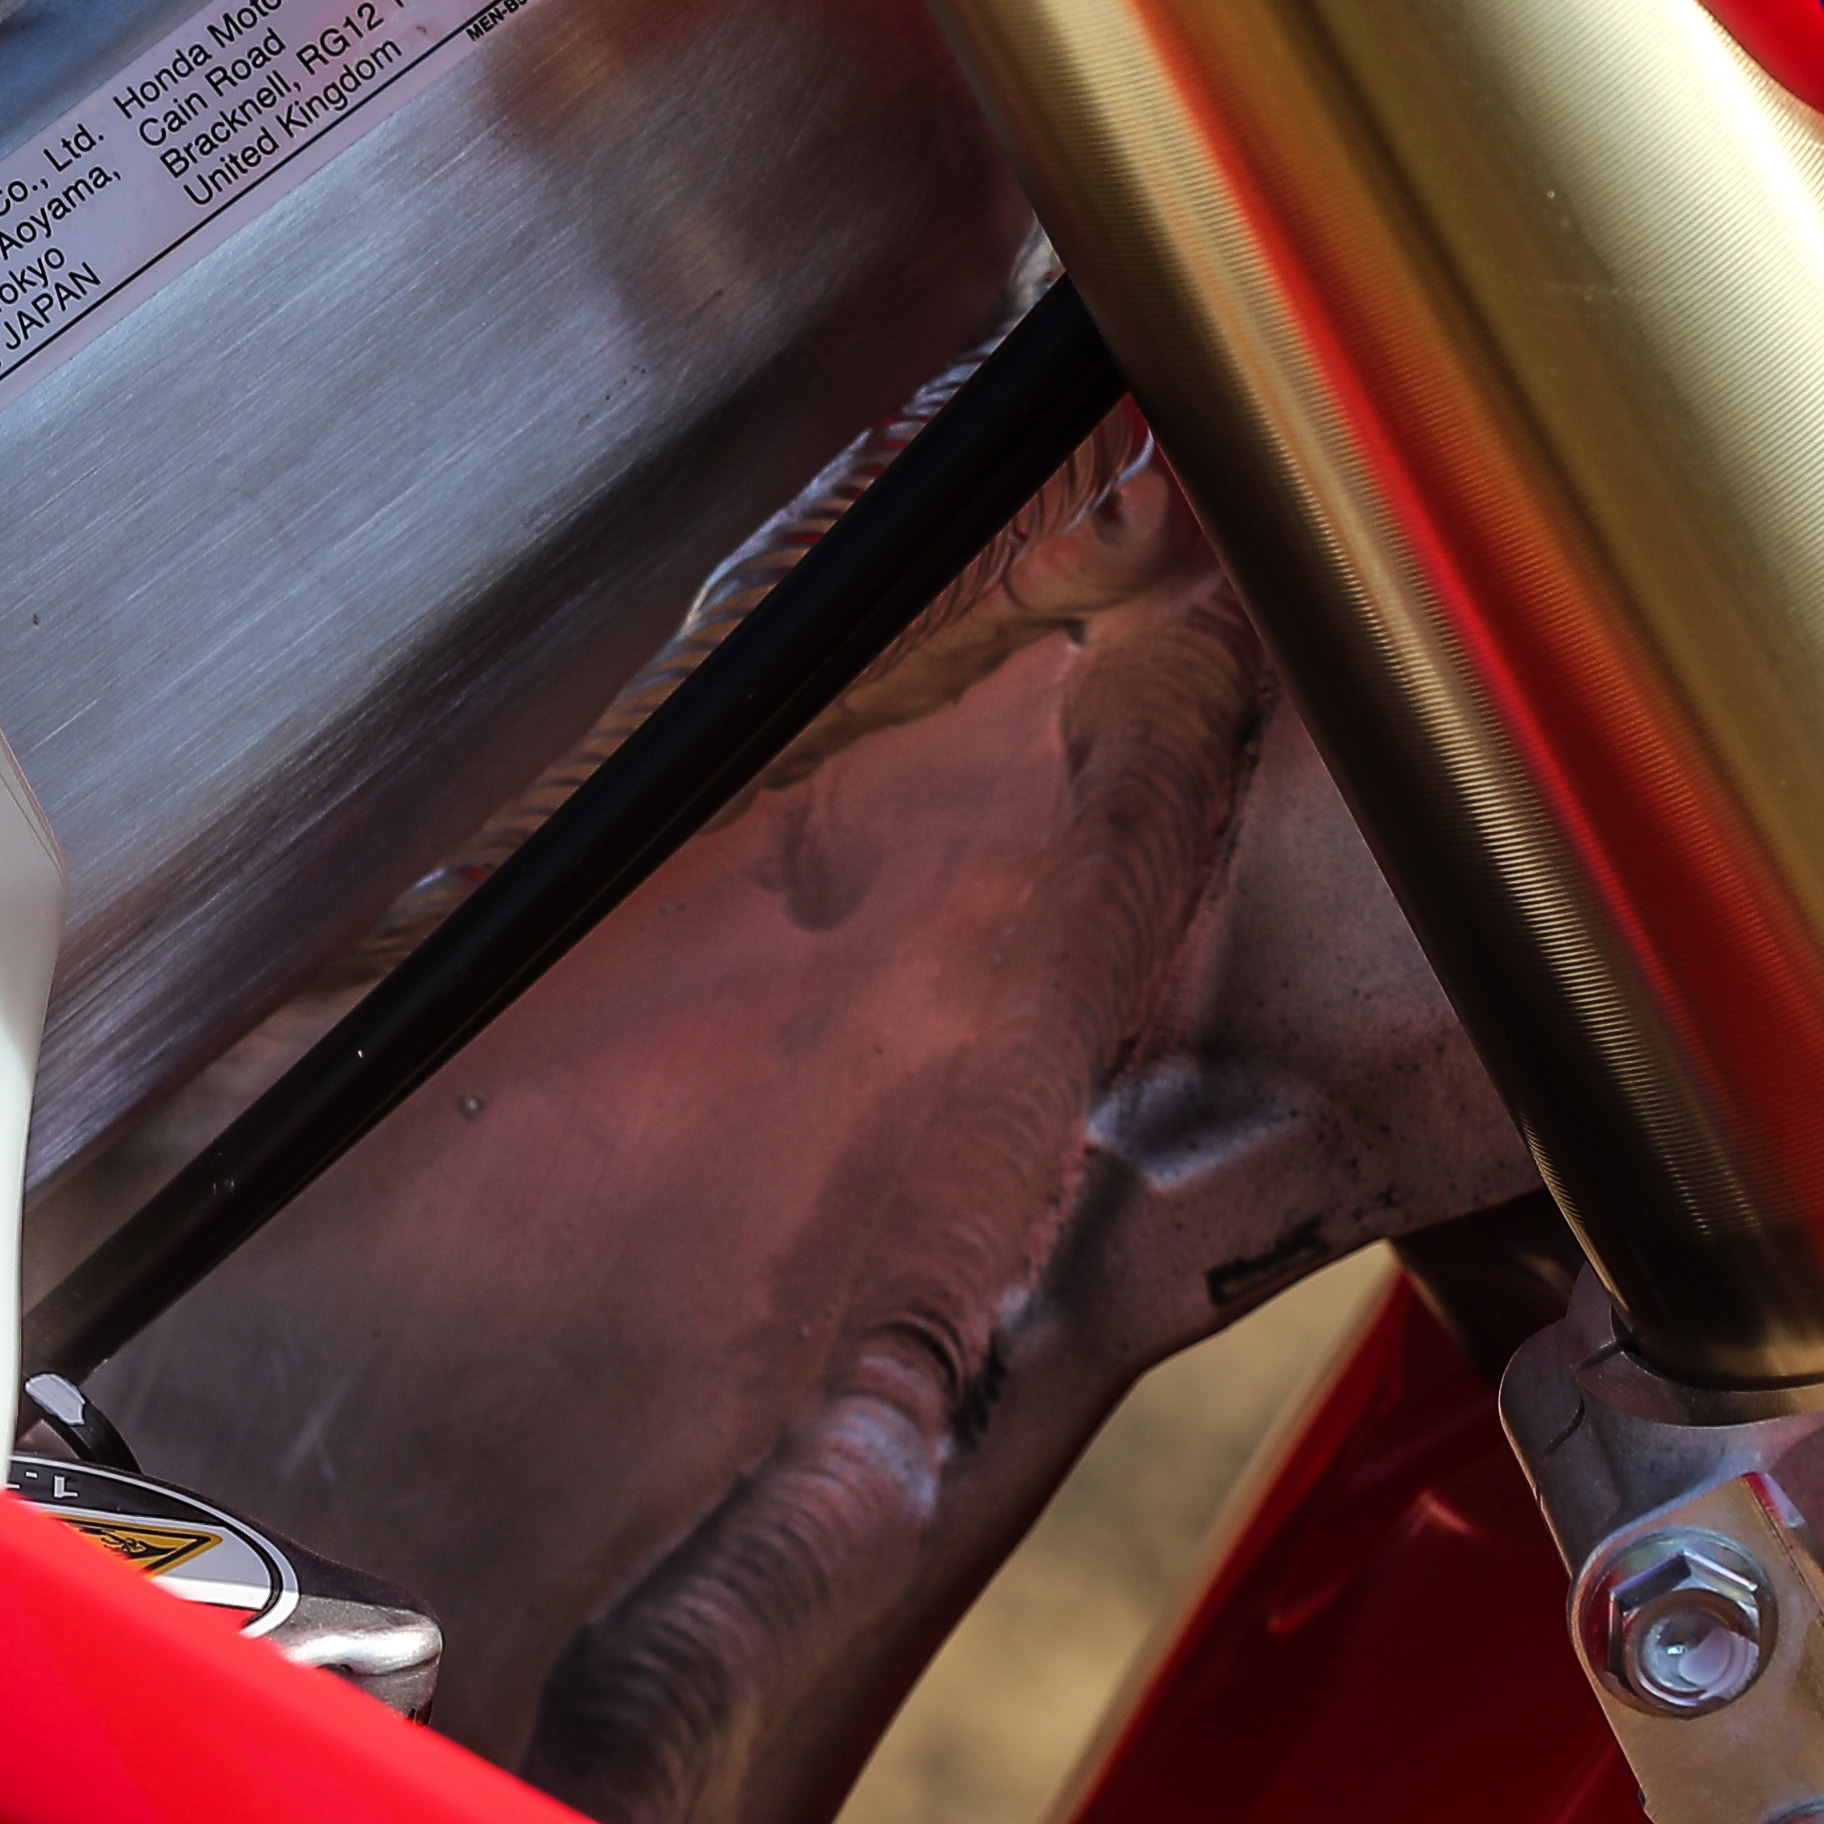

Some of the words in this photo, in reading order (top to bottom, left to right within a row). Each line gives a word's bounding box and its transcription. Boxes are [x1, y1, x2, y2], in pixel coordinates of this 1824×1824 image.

[112, 44, 213, 120] Honda
[139, 92, 209, 146] Cain
[204, 26, 287, 98] Road
[159, 69, 302, 179] Bracknell,
[295, 2, 385, 76] RG12
[183, 126, 280, 205] United
[275, 40, 402, 139] Kingdom
[43, 123, 104, 173] Ltd.
[3, 261, 101, 350] JAPAN
